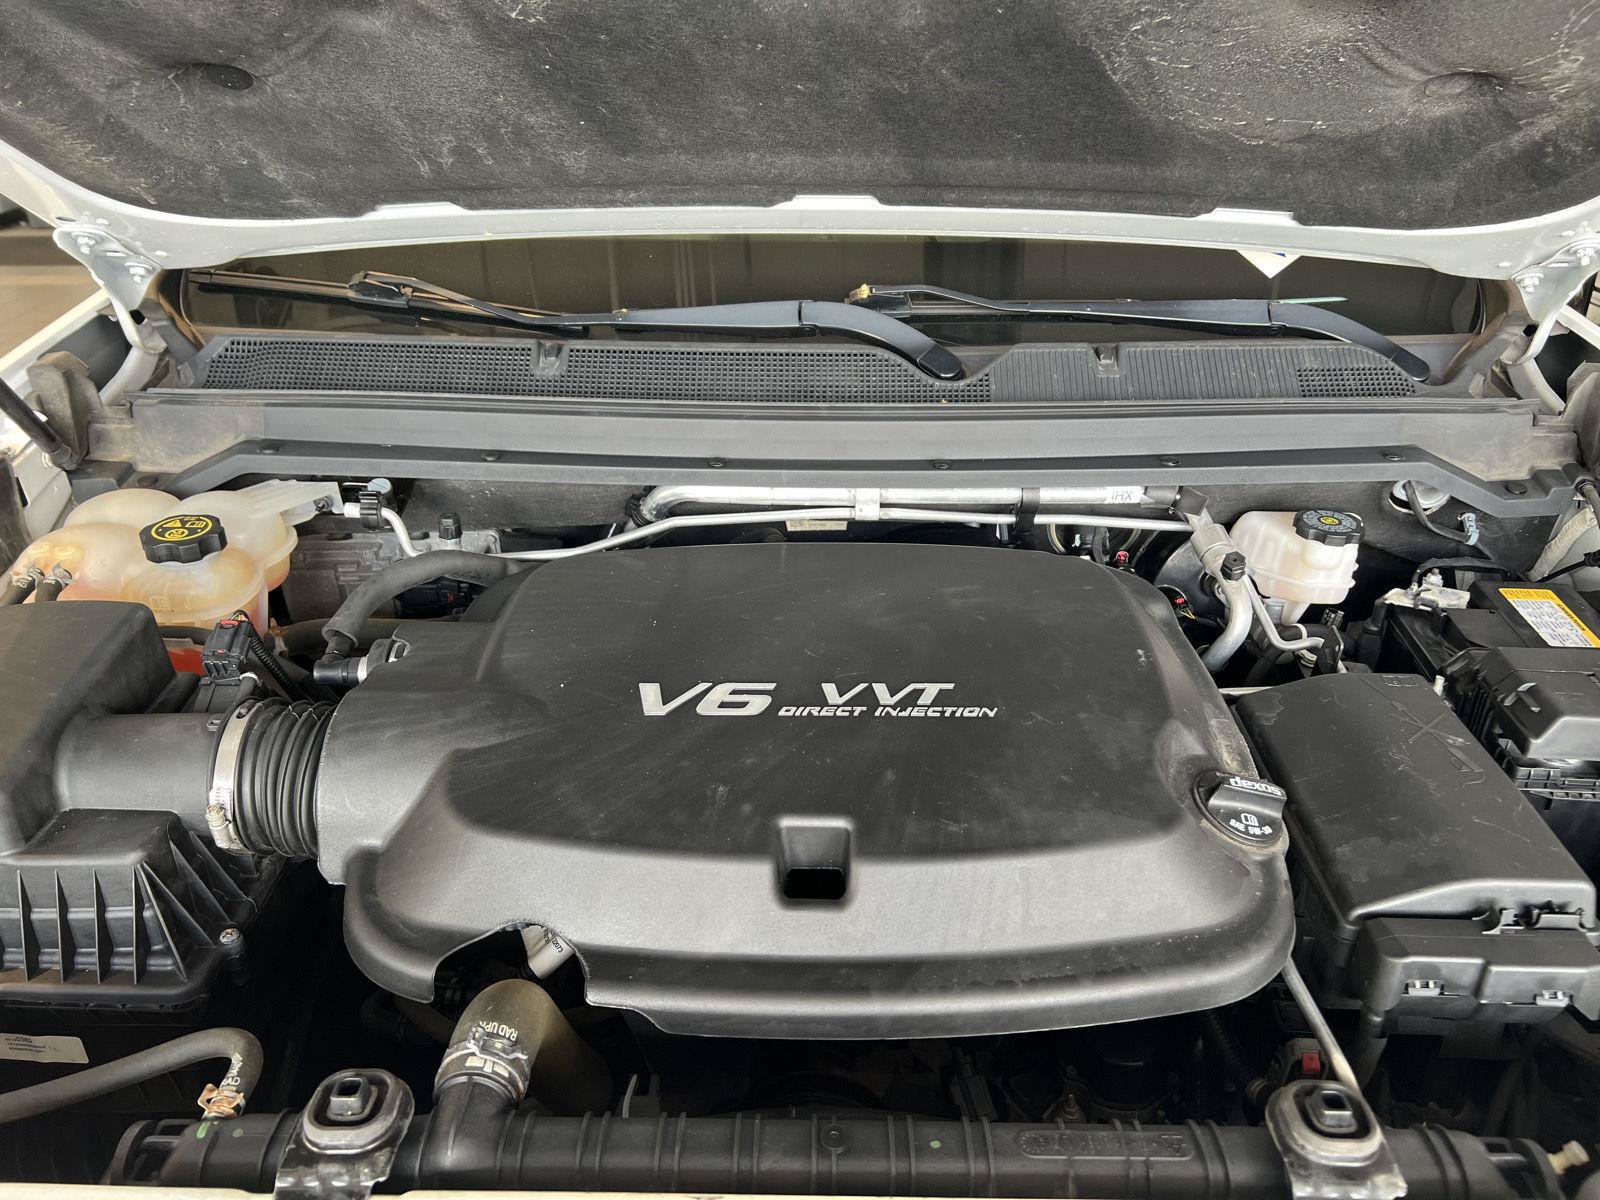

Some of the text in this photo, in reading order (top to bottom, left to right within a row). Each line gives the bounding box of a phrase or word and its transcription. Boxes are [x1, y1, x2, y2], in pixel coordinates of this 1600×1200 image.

[638, 682, 956, 717] V6 VVT
[777, 706, 998, 718] DIRECT INJECTION
[1229, 776, 1283, 796] dexos
[1229, 818, 1246, 832] SAE
[499, 1024, 519, 1042] RAD
